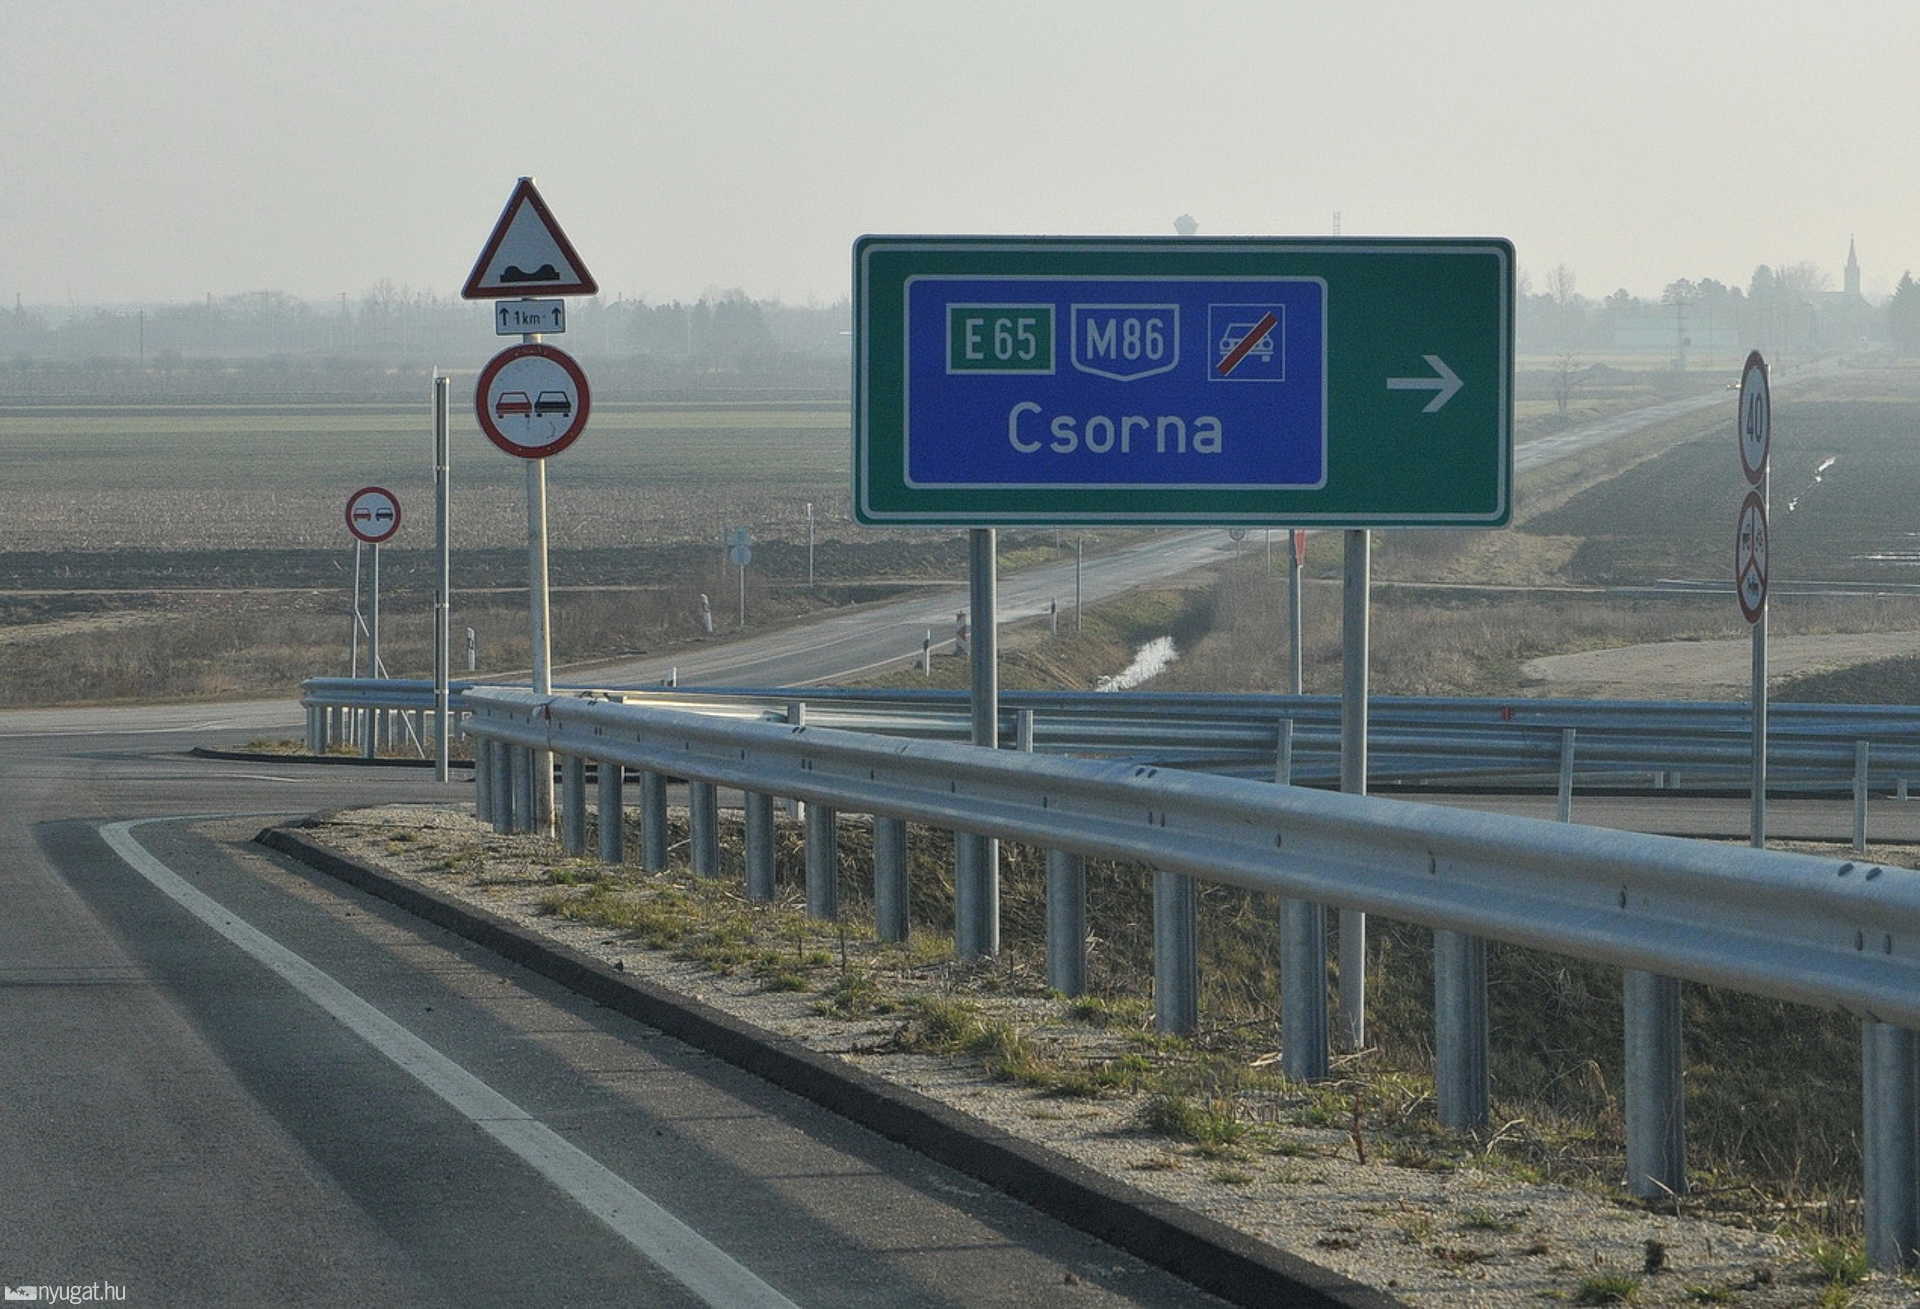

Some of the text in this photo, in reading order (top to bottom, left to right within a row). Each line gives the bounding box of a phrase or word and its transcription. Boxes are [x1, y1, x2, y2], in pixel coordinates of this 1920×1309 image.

[1086, 318, 1164, 360] M86
[1008, 401, 1222, 454] Csorna
[1746, 393, 1763, 443] 40
